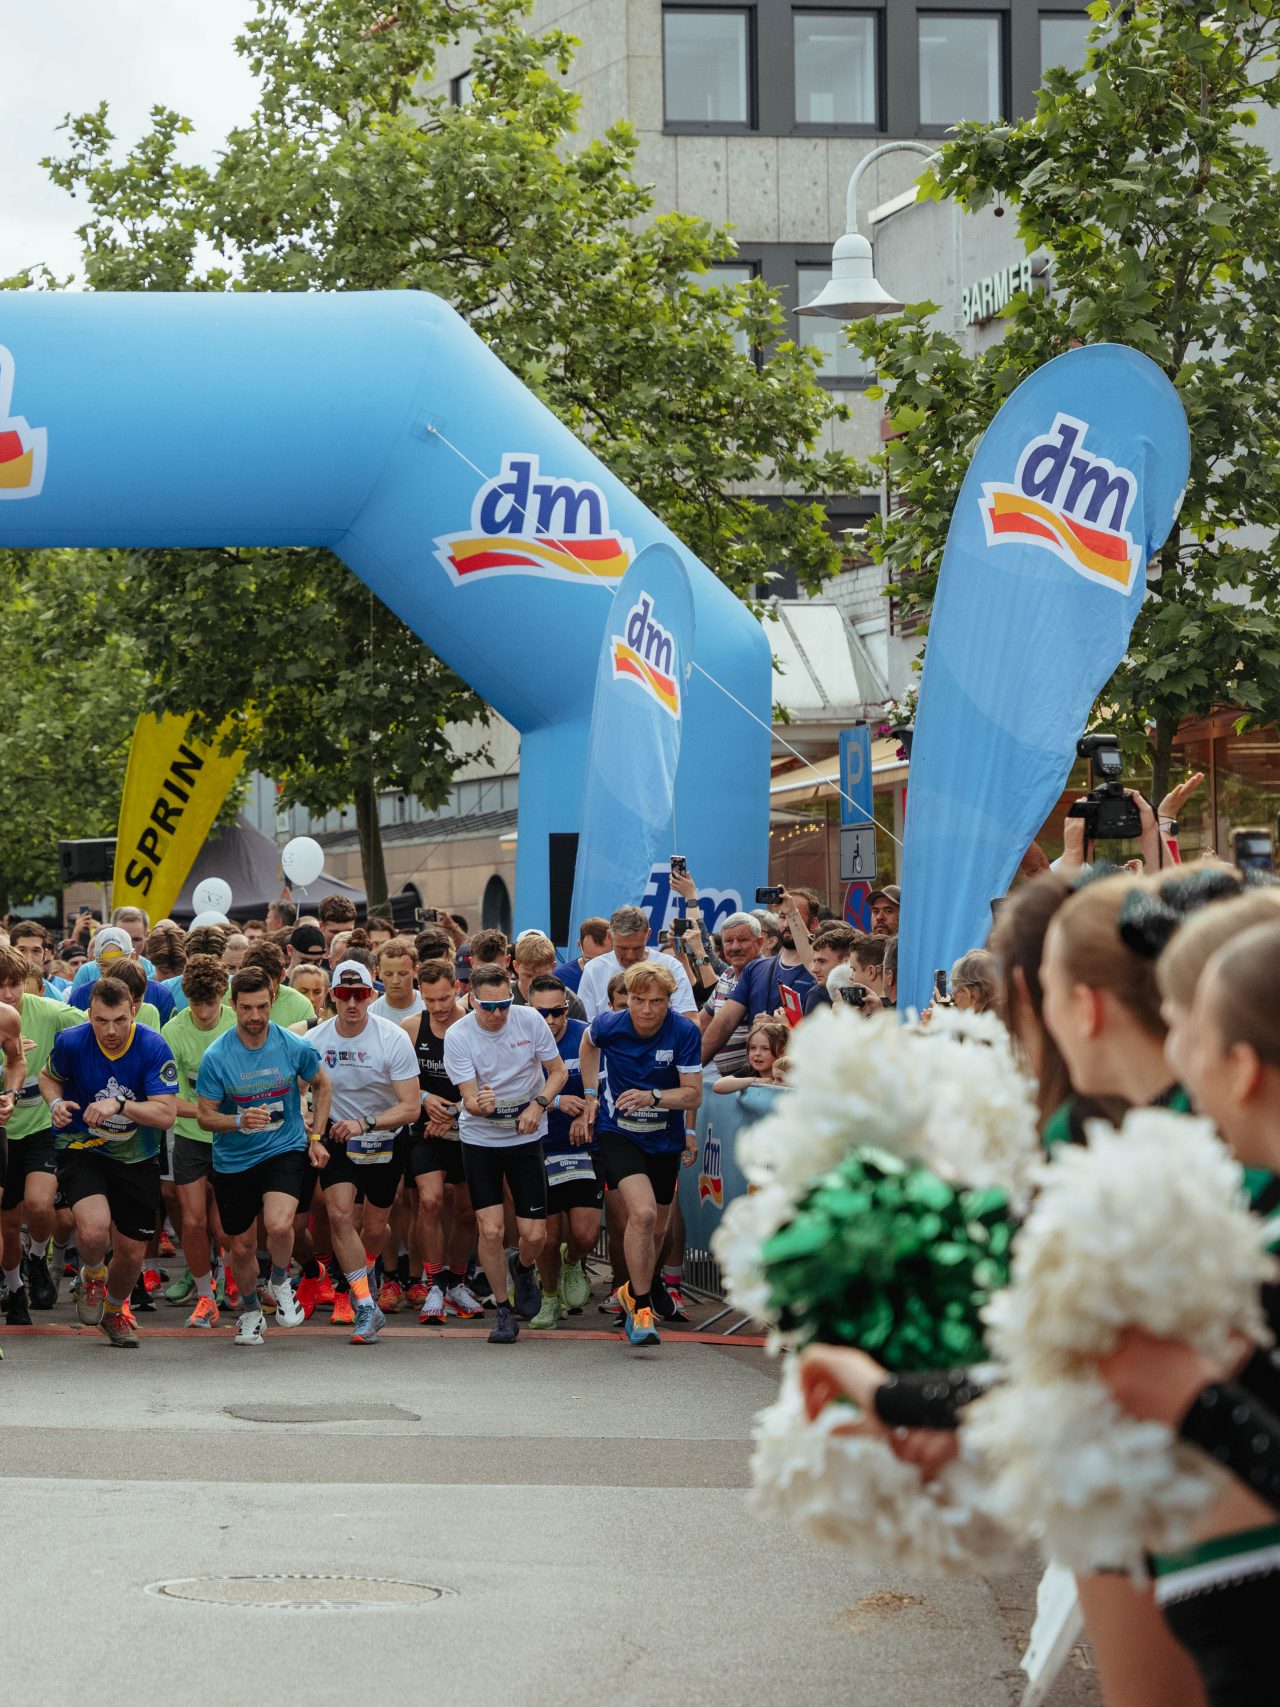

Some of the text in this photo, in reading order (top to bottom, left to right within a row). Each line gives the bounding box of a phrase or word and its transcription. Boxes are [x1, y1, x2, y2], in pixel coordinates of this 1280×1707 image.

[962, 257, 1032, 328] BARMER
[480, 461, 602, 535] dm
[1021, 423, 1130, 532] dm
[627, 598, 672, 675] dm
[125, 713, 214, 896] SPRIN
[847, 741, 863, 813] P
[360, 1140, 382, 1149] Martin
[496, 1106, 519, 1114] Stefan
[704, 1128, 720, 1176] dm
